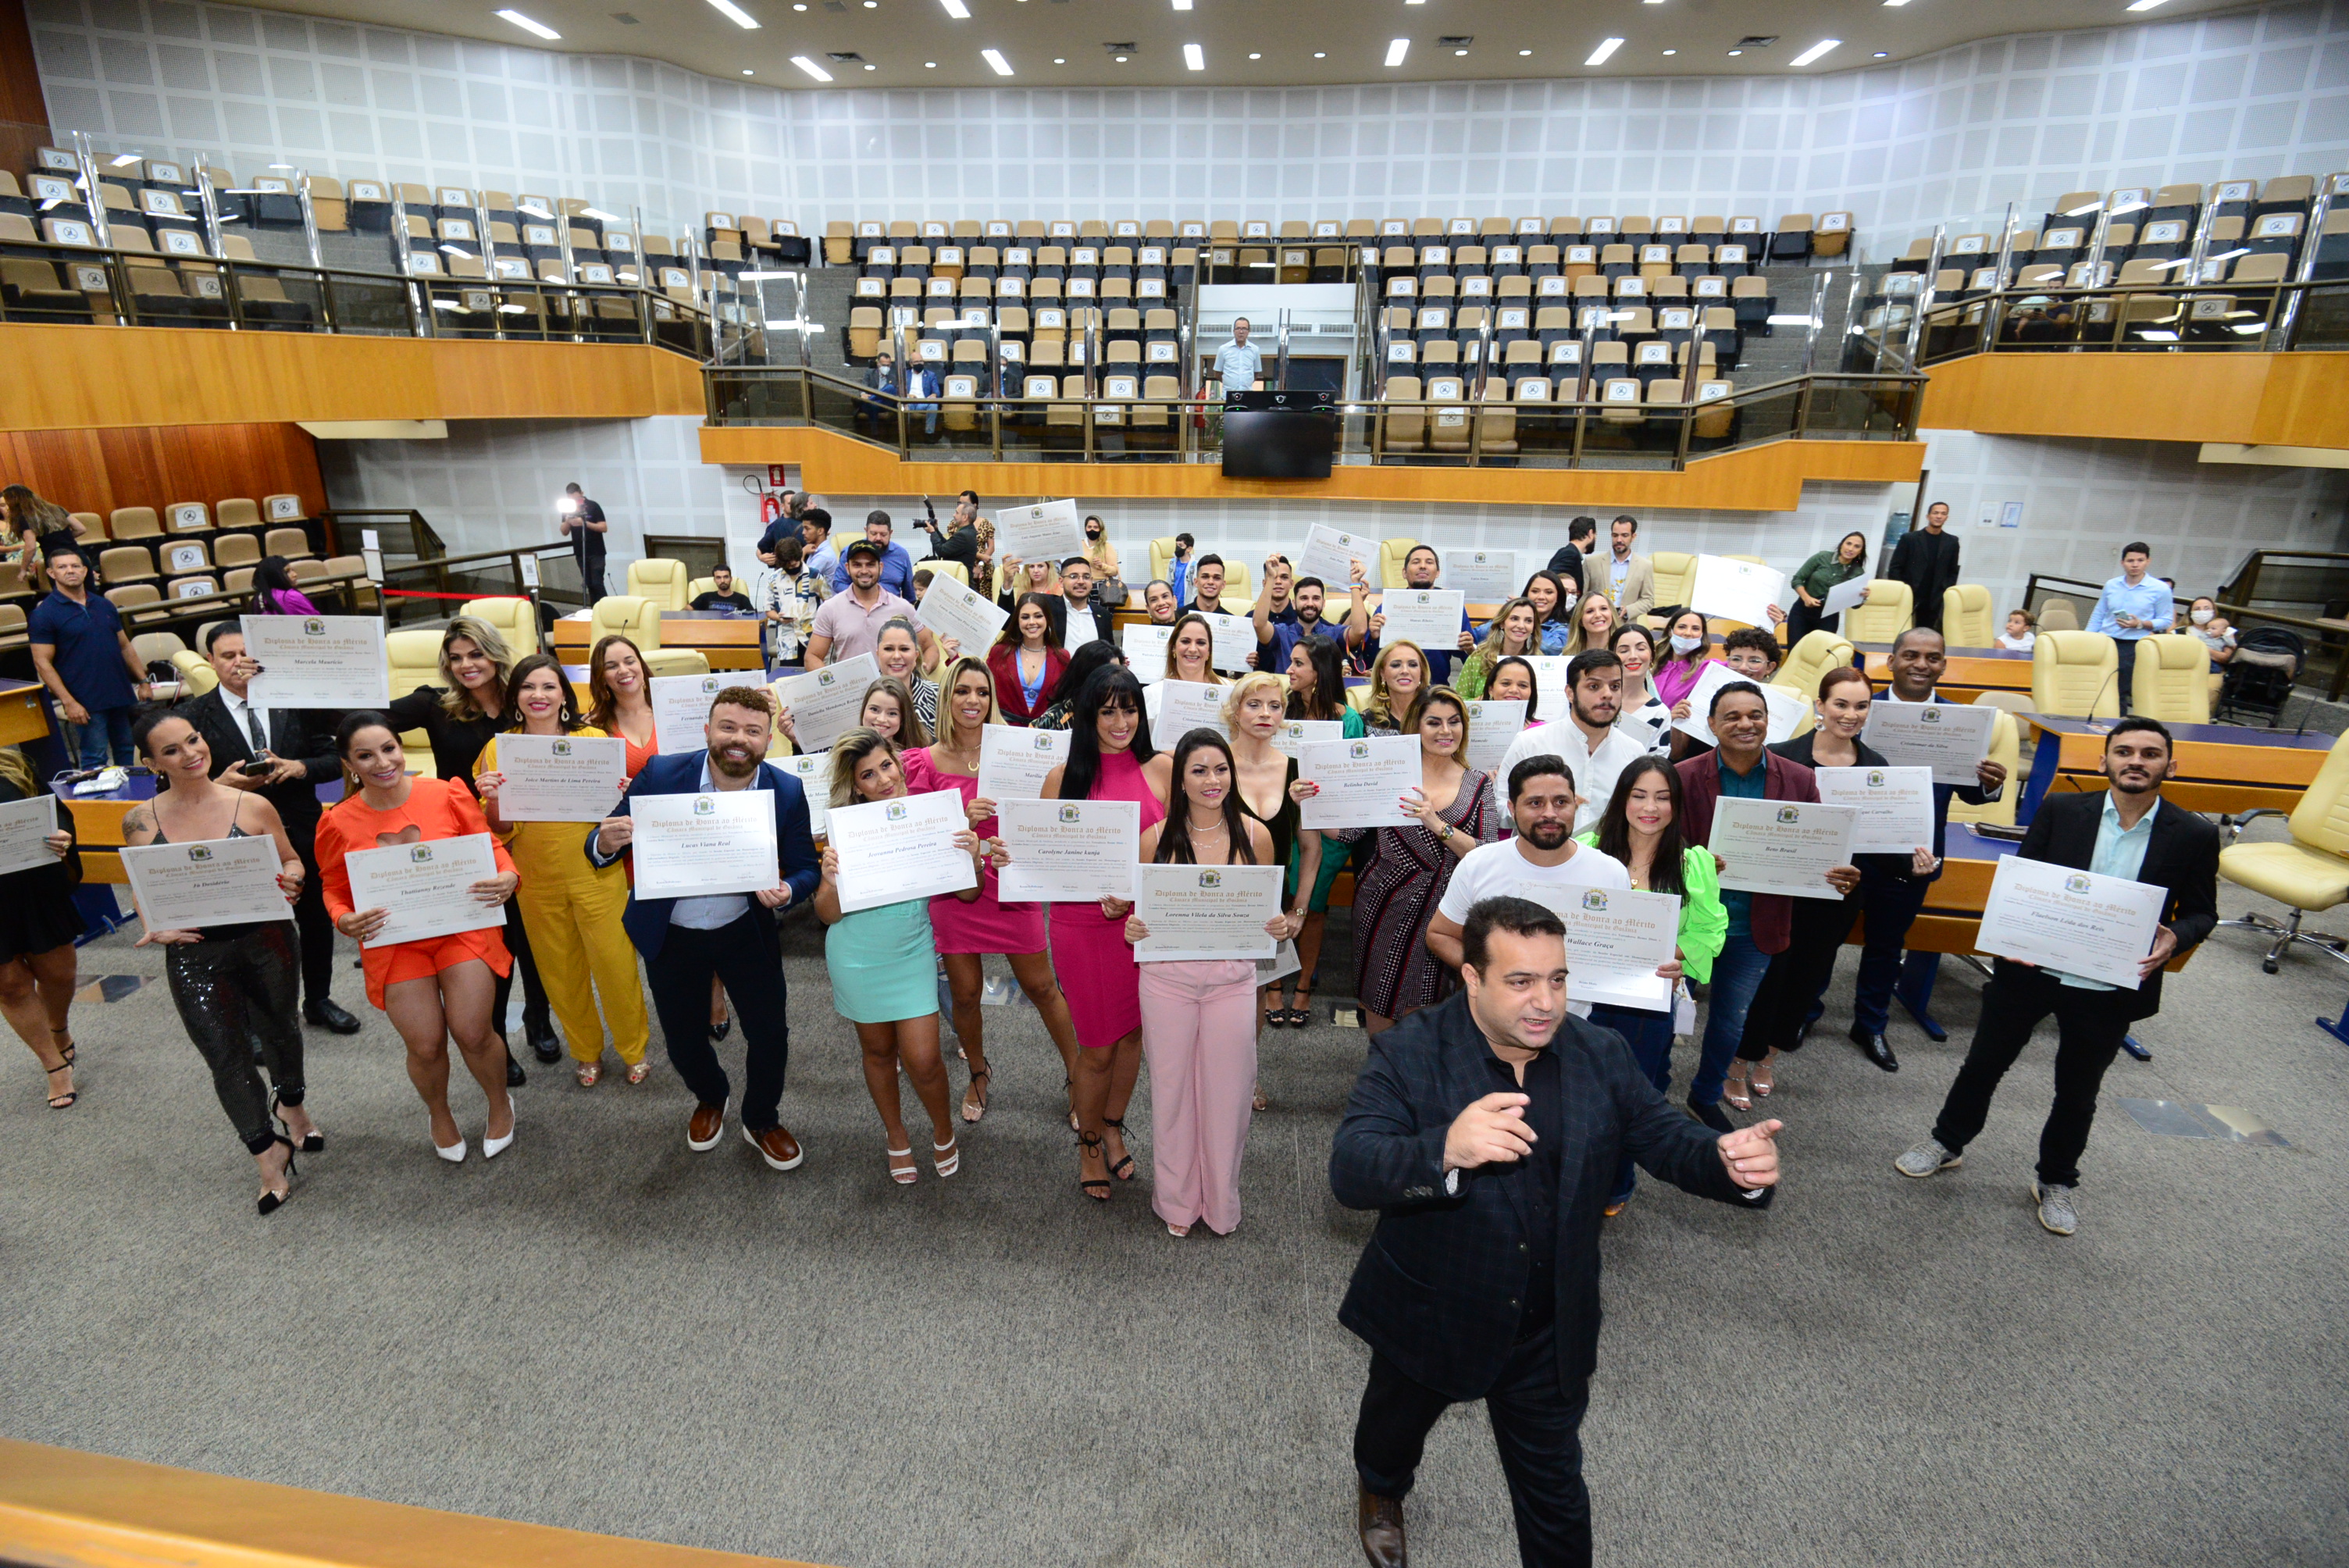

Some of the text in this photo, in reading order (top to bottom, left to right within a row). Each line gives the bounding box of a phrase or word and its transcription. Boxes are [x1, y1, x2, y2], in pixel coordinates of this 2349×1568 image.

[514, 757, 543, 765] Diploma
[697, 818, 719, 826] Honra
[733, 816, 757, 825] Mérito
[848, 828, 879, 839] Diploma
[890, 822, 912, 831] Honra
[925, 816, 948, 826] Mérito
[1732, 821, 1763, 831] Diploma
[1813, 828, 1838, 836] Mérito
[1018, 825, 1049, 833] Diploma
[895, 845, 916, 853] Pedrosa
[918, 841, 937, 850] Pereira
[148, 866, 182, 876] Diploma
[233, 857, 260, 866] Mérito
[370, 870, 402, 879] Diploma
[415, 864, 438, 873] Honra
[451, 859, 476, 868] Mérito
[433, 882, 456, 891] Rezende
[2014, 882, 2049, 896] Diploma
[2063, 893, 2091, 906] Honra
[2106, 903, 2137, 916] Mérito
[1583, 913, 1610, 923] Honra
[1624, 918, 1656, 929] Mérito
[2060, 917, 2076, 926] Léda
[2091, 923, 2105, 932] Reis
[1567, 938, 1614, 950] Wallace Graça
